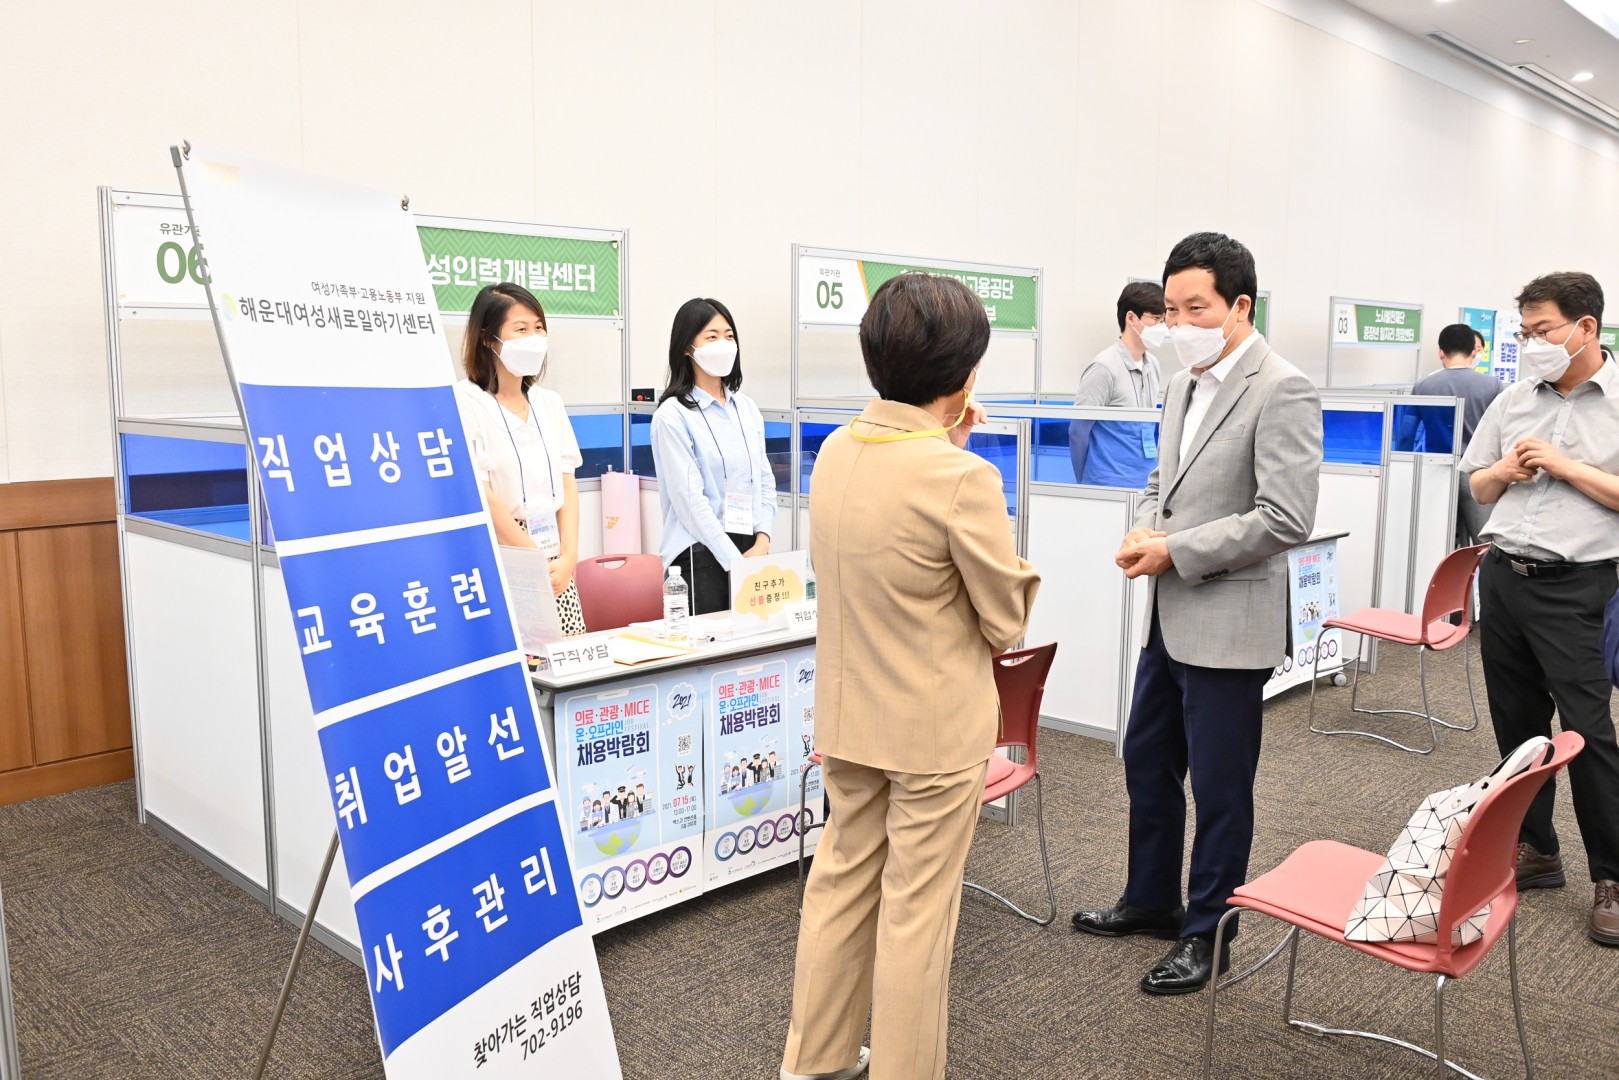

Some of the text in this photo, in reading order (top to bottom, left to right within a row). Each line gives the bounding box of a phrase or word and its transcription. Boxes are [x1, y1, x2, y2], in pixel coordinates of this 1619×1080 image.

[156, 241, 213, 285] 06
[405, 291, 426, 305] 지원
[816, 280, 844, 310] 05
[238, 296, 436, 335] 해운대여성새로일하기센터
[1337, 316, 1349, 335] 03
[552, 643, 609, 667] 구직상담
[798, 668, 815, 684] 2021
[672, 693, 693, 710] 2021
[624, 722, 650, 733] FESTIVAL
[719, 702, 781, 737] 채용박람회
[577, 731, 650, 766] 채용박람회
[473, 970, 582, 1069] 찾아가는 직업상담
[520, 999, 583, 1061] 702-9196
